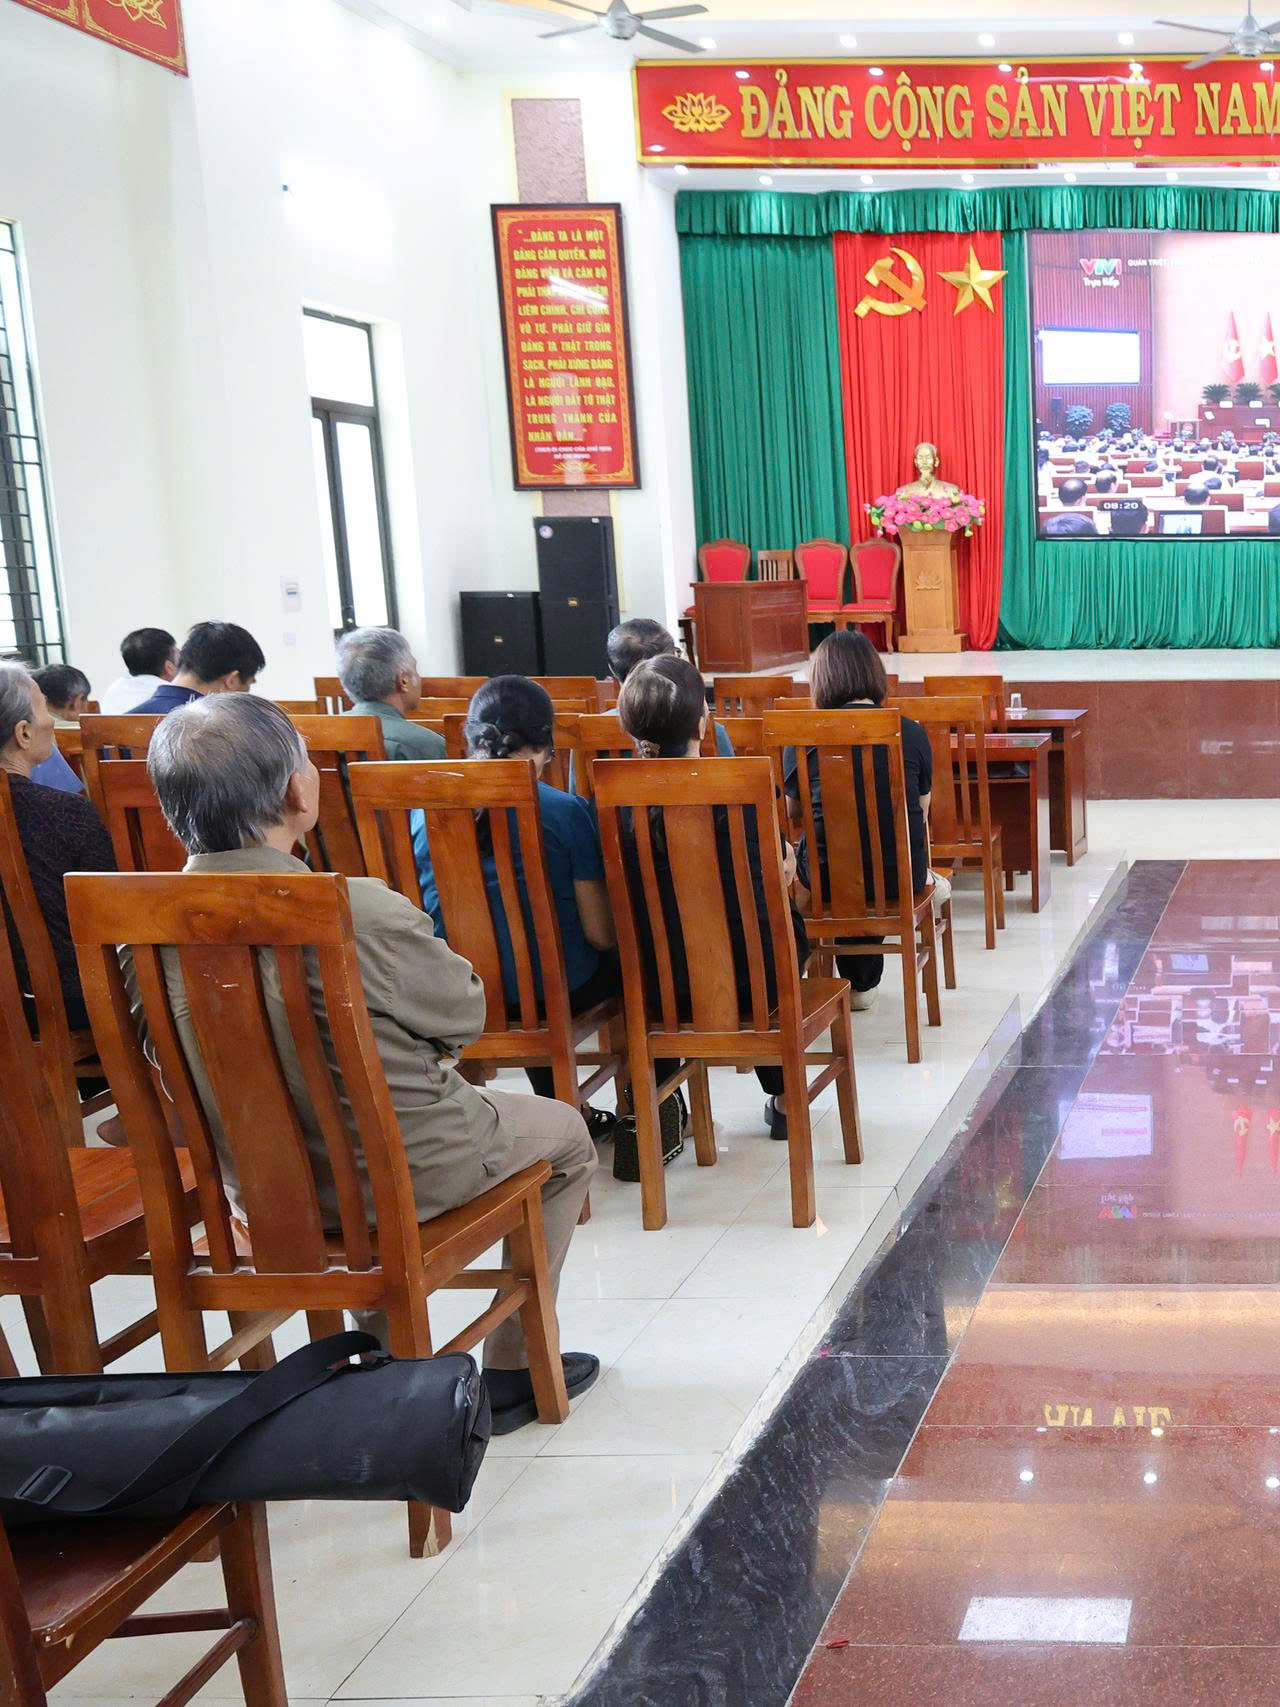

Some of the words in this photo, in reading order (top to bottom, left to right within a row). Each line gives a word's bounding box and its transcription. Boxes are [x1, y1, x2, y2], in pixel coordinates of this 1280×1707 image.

[740, 68, 853, 139] ĐẢNG
[864, 71, 974, 152] CỘNG
[986, 66, 1067, 137] SẢN
[1079, 70, 1181, 149] VIỆT
[1080, 258, 1122, 276] VTV1
[1083, 277, 1101, 288] Trực
[1102, 276, 1120, 288] tiếp
[584, 339, 612, 352] TRONG
[527, 411, 557, 424] TRUNG
[1103, 502, 1139, 510] 08:20
